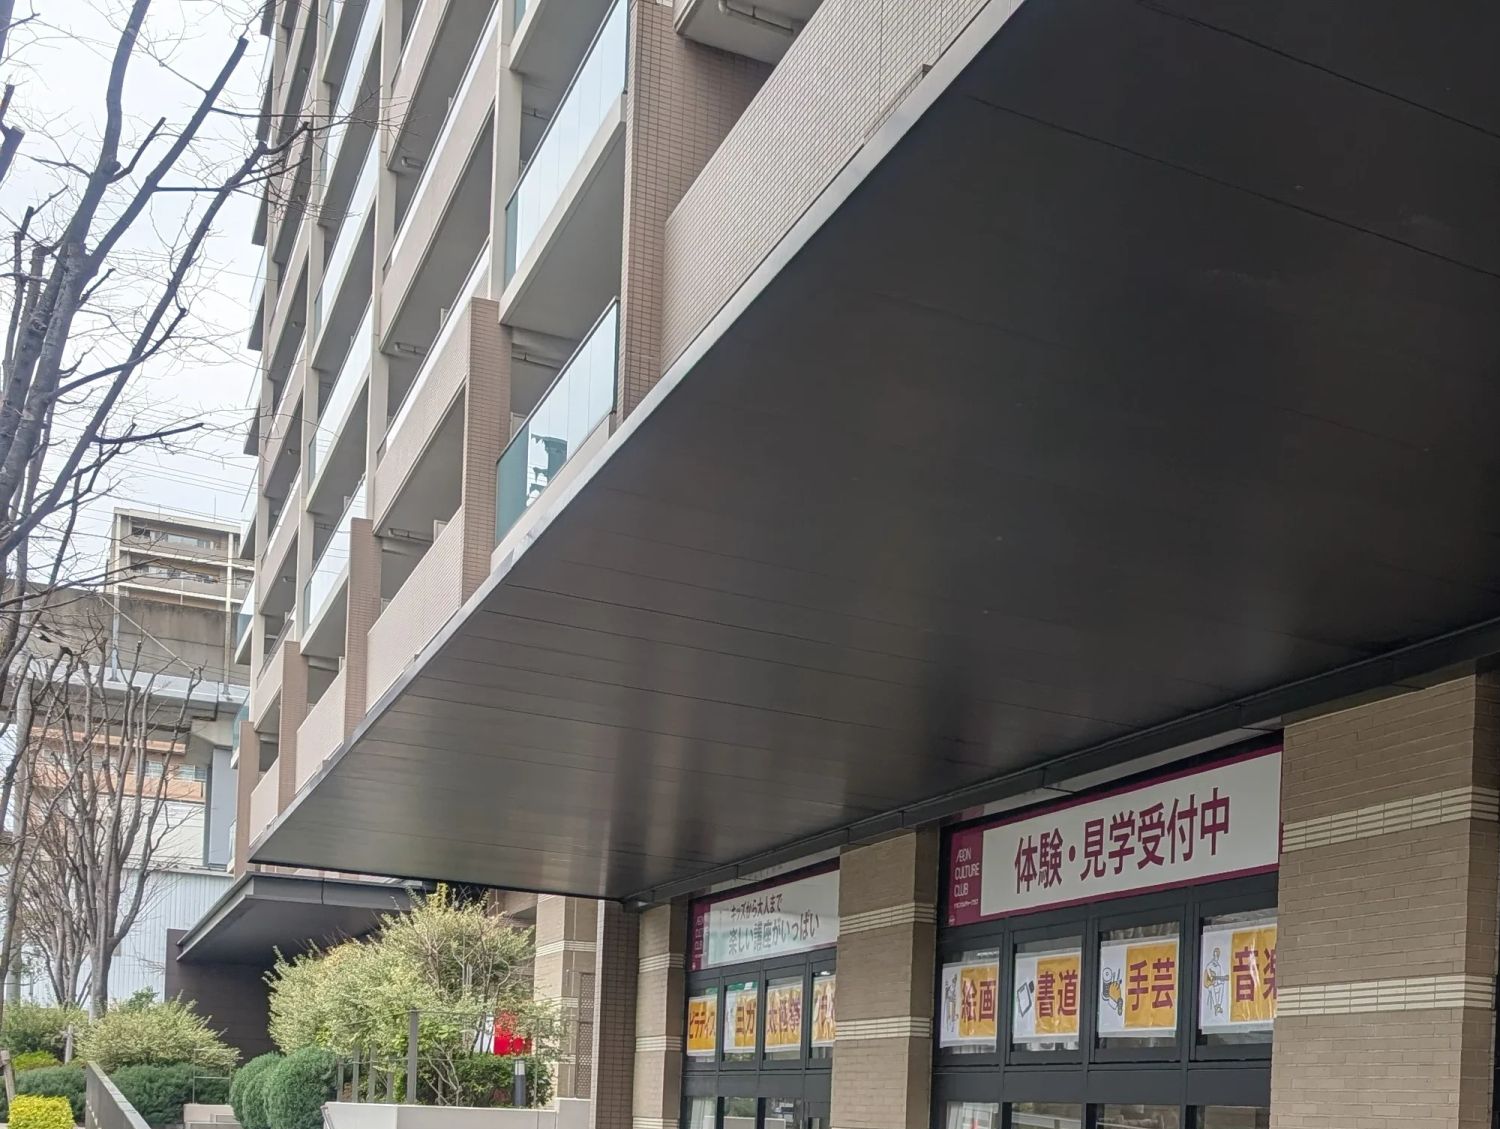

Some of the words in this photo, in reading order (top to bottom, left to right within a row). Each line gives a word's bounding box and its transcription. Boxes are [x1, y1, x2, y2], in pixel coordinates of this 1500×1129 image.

[1014, 787, 1231, 894] 体験・見学受付中
[953, 883, 969, 898] CLUB
[954, 863, 980, 881] CULTURE
[728, 910, 820, 955] 楽しい講座がいっぱい
[961, 961, 997, 1023] 絵画
[1036, 956, 1080, 1020] 書道
[1126, 952, 1175, 1013] 手芸
